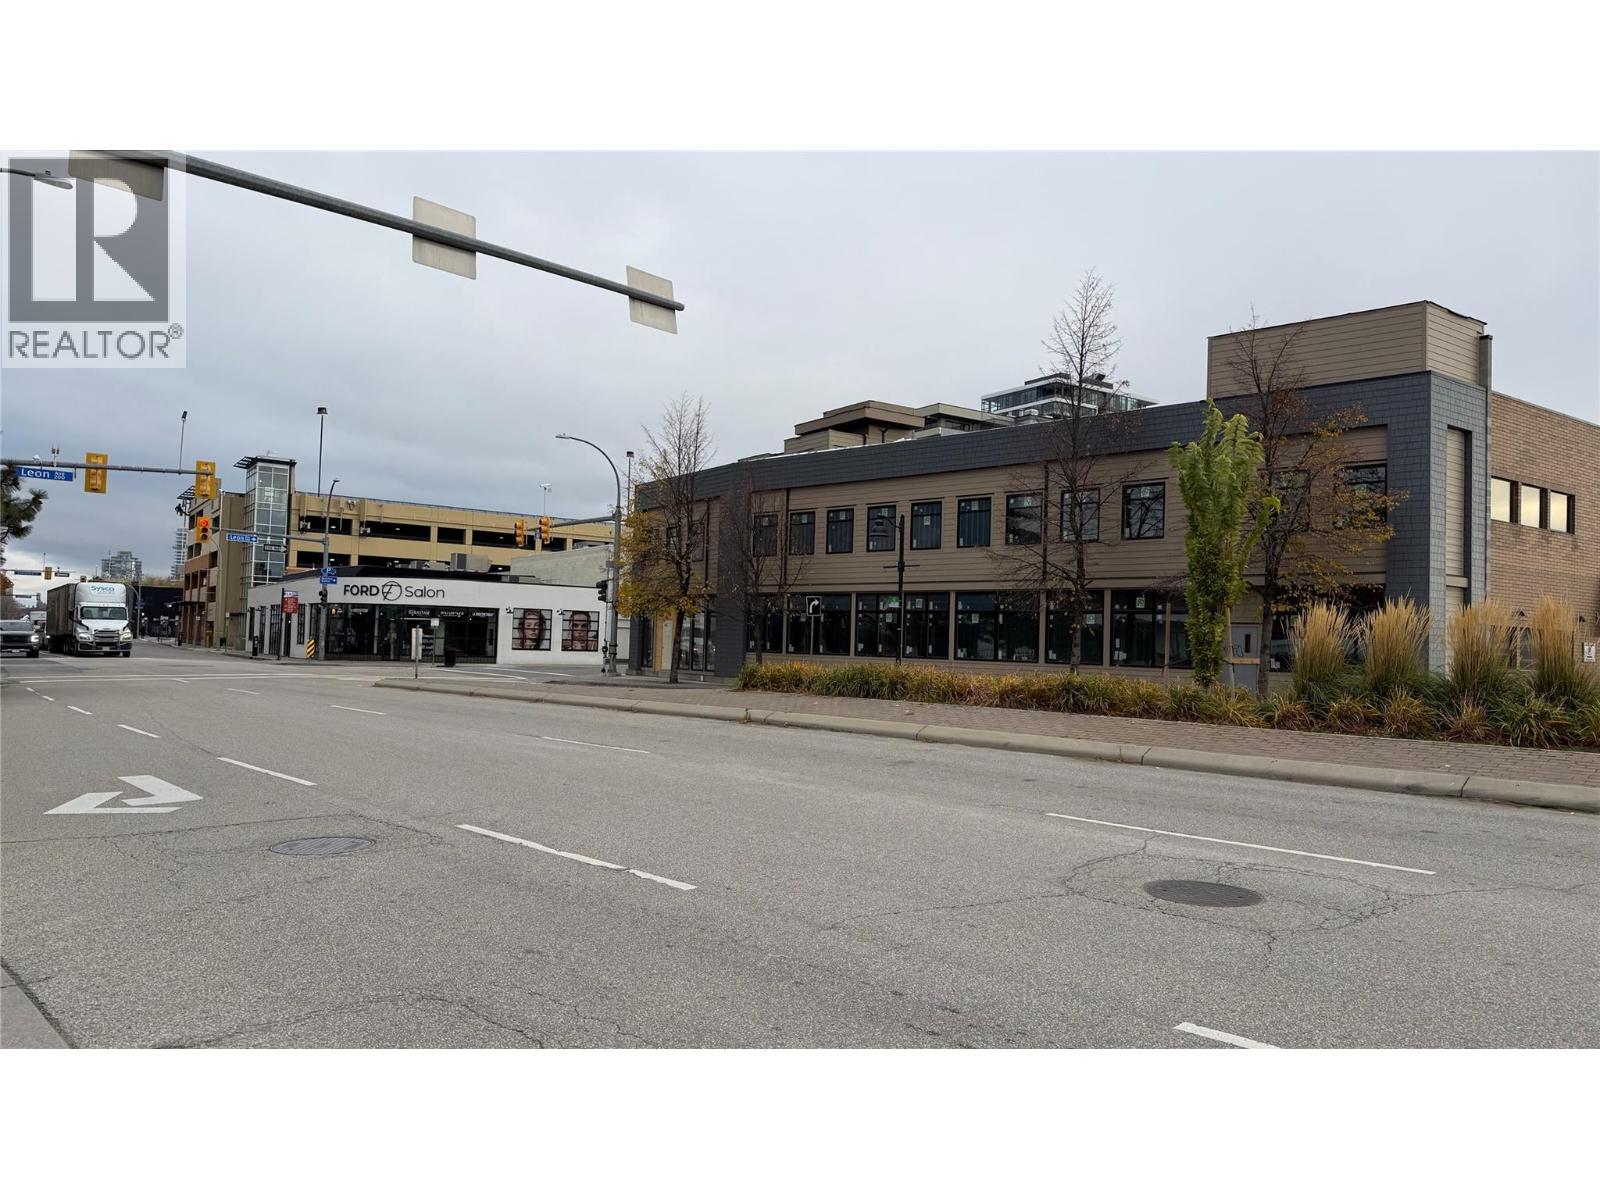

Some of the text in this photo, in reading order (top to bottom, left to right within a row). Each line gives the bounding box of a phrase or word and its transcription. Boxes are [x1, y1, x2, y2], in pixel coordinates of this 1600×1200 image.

[21, 468, 50, 478] Leon
[343, 584, 380, 597] FORD
[404, 585, 445, 599] Salon
